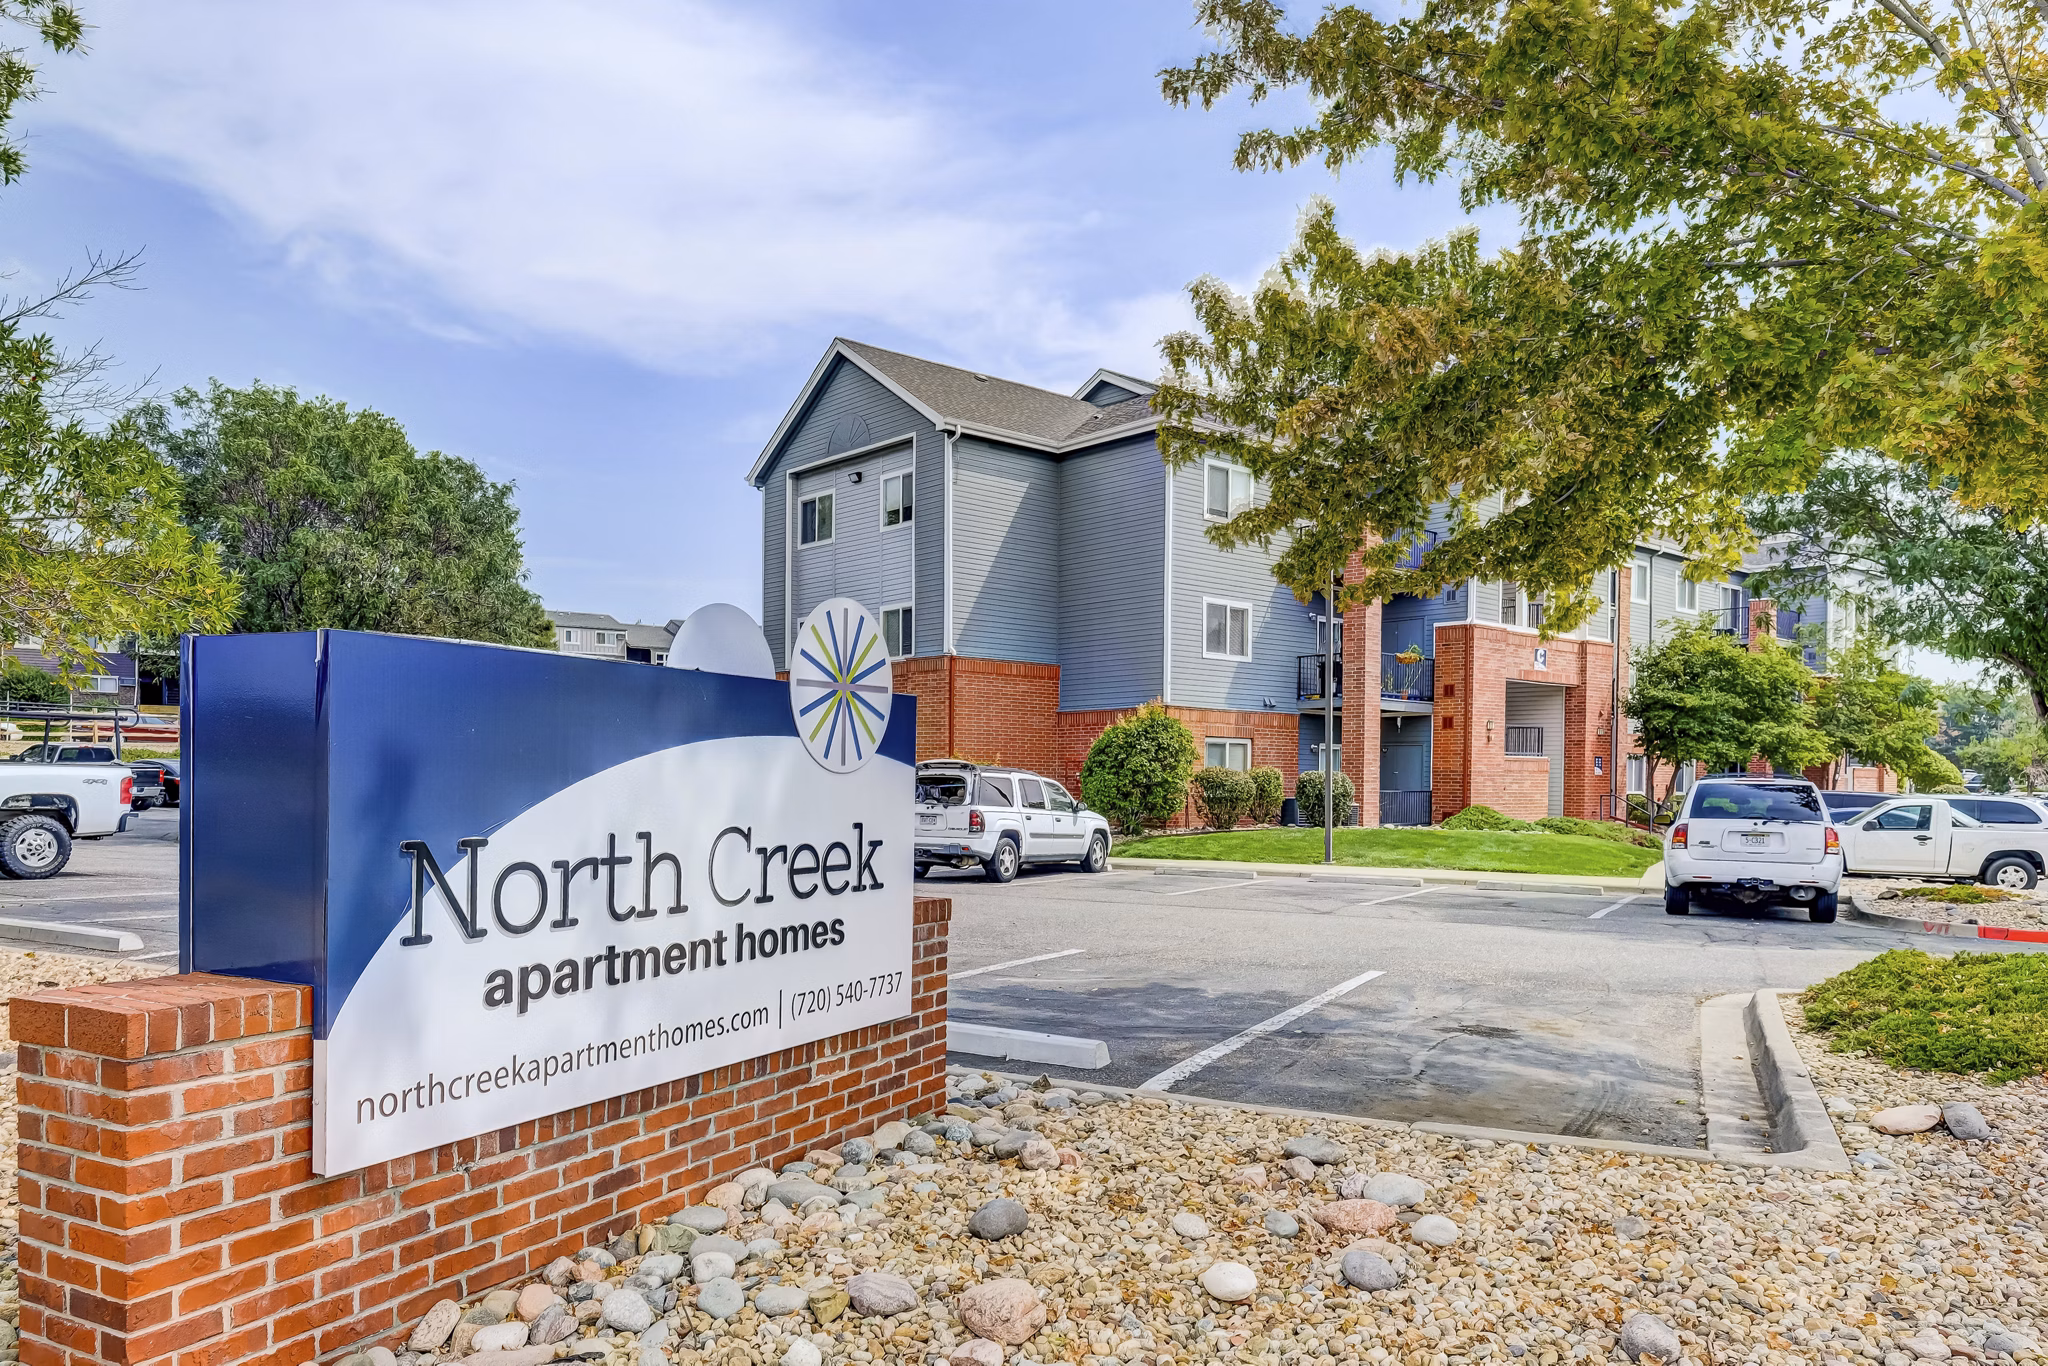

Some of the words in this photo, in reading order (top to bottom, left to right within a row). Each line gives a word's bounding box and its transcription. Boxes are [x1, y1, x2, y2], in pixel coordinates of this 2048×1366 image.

[1536, 649, 1545, 663] C
[400, 831, 688, 946] North
[708, 822, 884, 907] Creek
[483, 929, 727, 1016] apartment
[734, 918, 845, 963] homes
[356, 1006, 769, 1124] northcreekapartmenthomes.com
[791, 986, 831, 1021] (720)
[835, 971, 903, 1006] 540-7737
